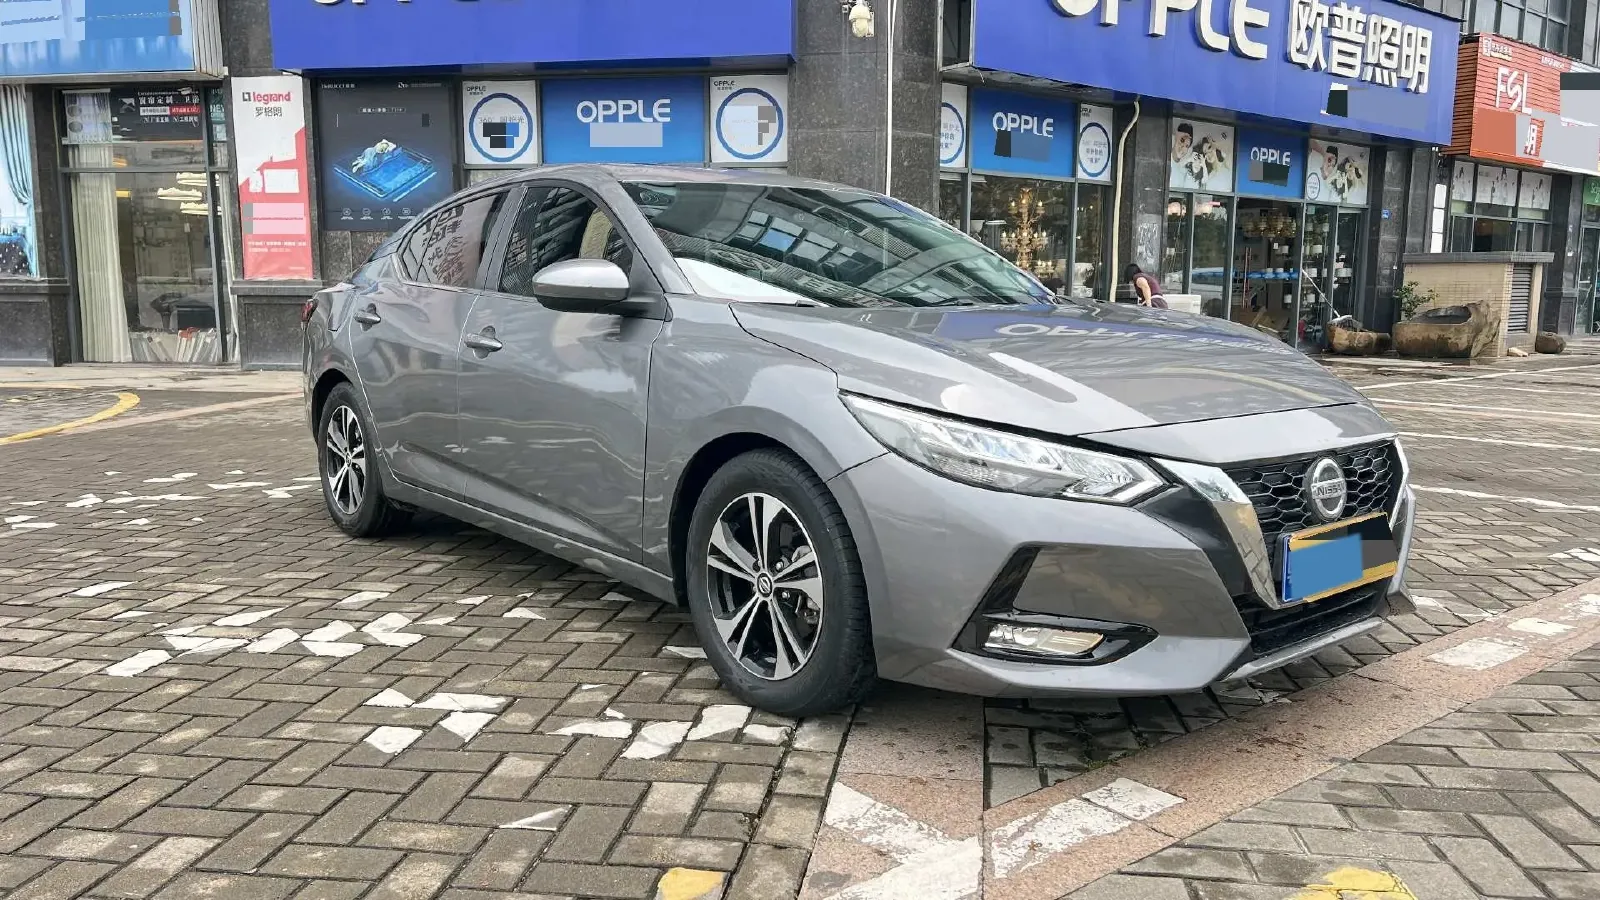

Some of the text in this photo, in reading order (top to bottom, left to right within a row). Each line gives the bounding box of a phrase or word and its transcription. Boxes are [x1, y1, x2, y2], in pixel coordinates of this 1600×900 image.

[1286, 0, 1433, 94] 欧普照明
[252, 91, 291, 105] legrand
[1495, 66, 1532, 115] FSL
[255, 106, 283, 118] 罗格朗
[576, 98, 671, 123] OPPLE
[992, 111, 1054, 138] OPPLE
[1250, 146, 1291, 167] OPPLE
